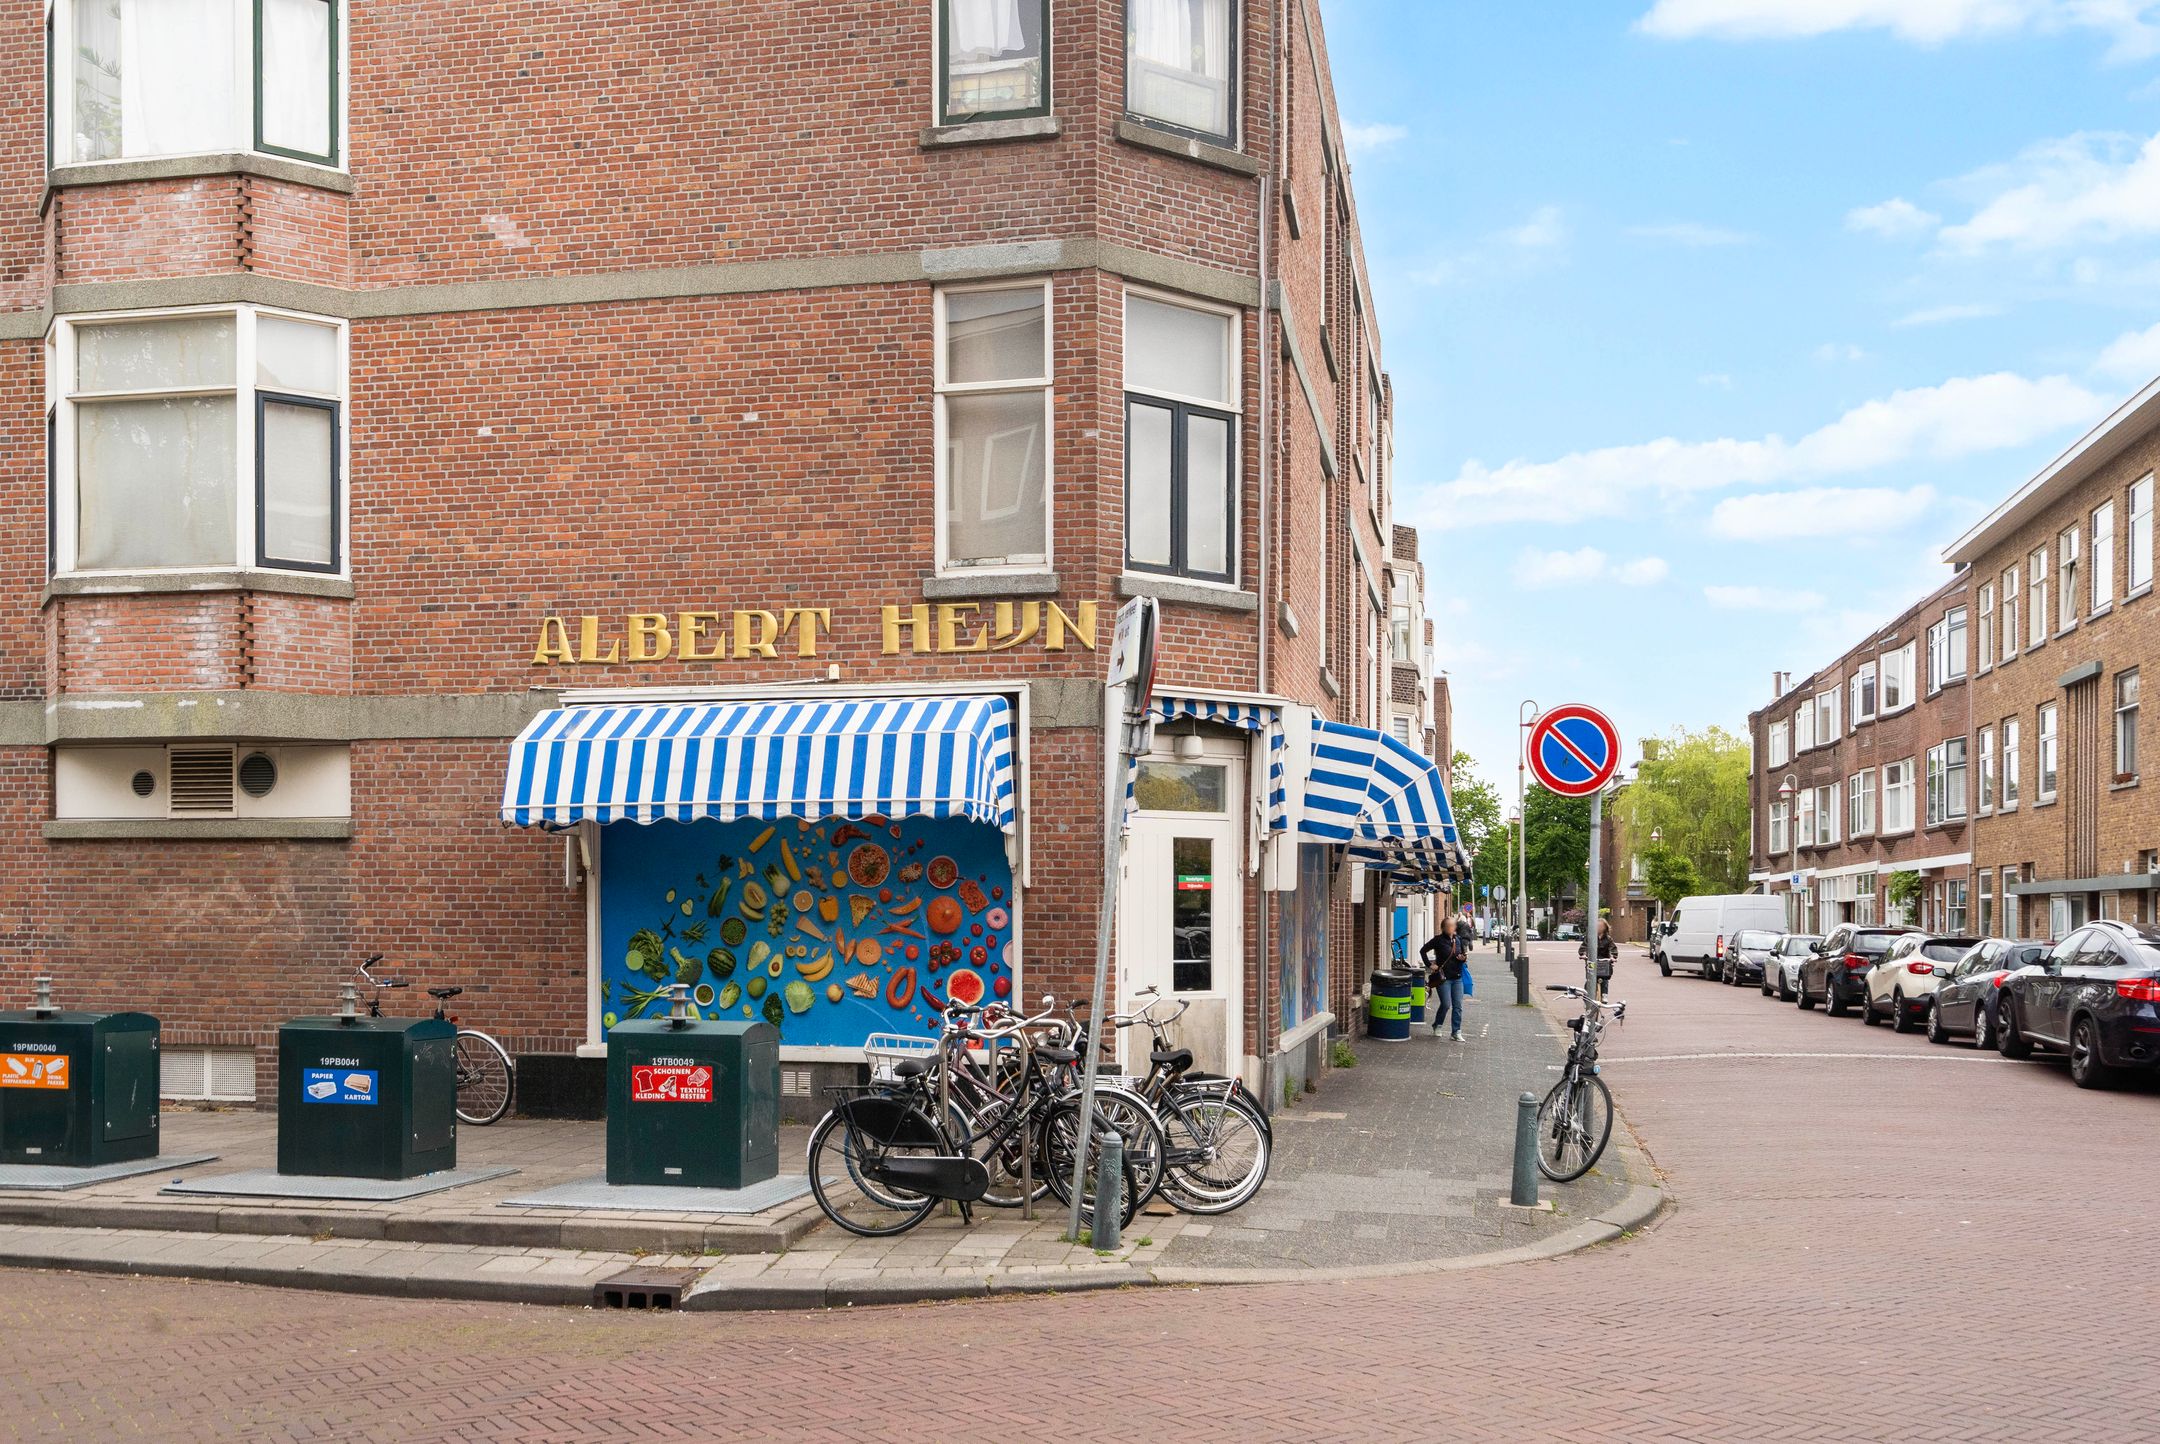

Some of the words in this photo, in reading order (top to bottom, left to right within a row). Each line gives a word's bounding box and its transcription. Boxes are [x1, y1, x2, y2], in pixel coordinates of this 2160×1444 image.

[531, 607, 831, 664] ALBERT
[13, 1043, 57, 1052] 19PMD0040
[320, 1057, 360, 1066] 19PB0041
[652, 1057, 694, 1066] 19TB0049
